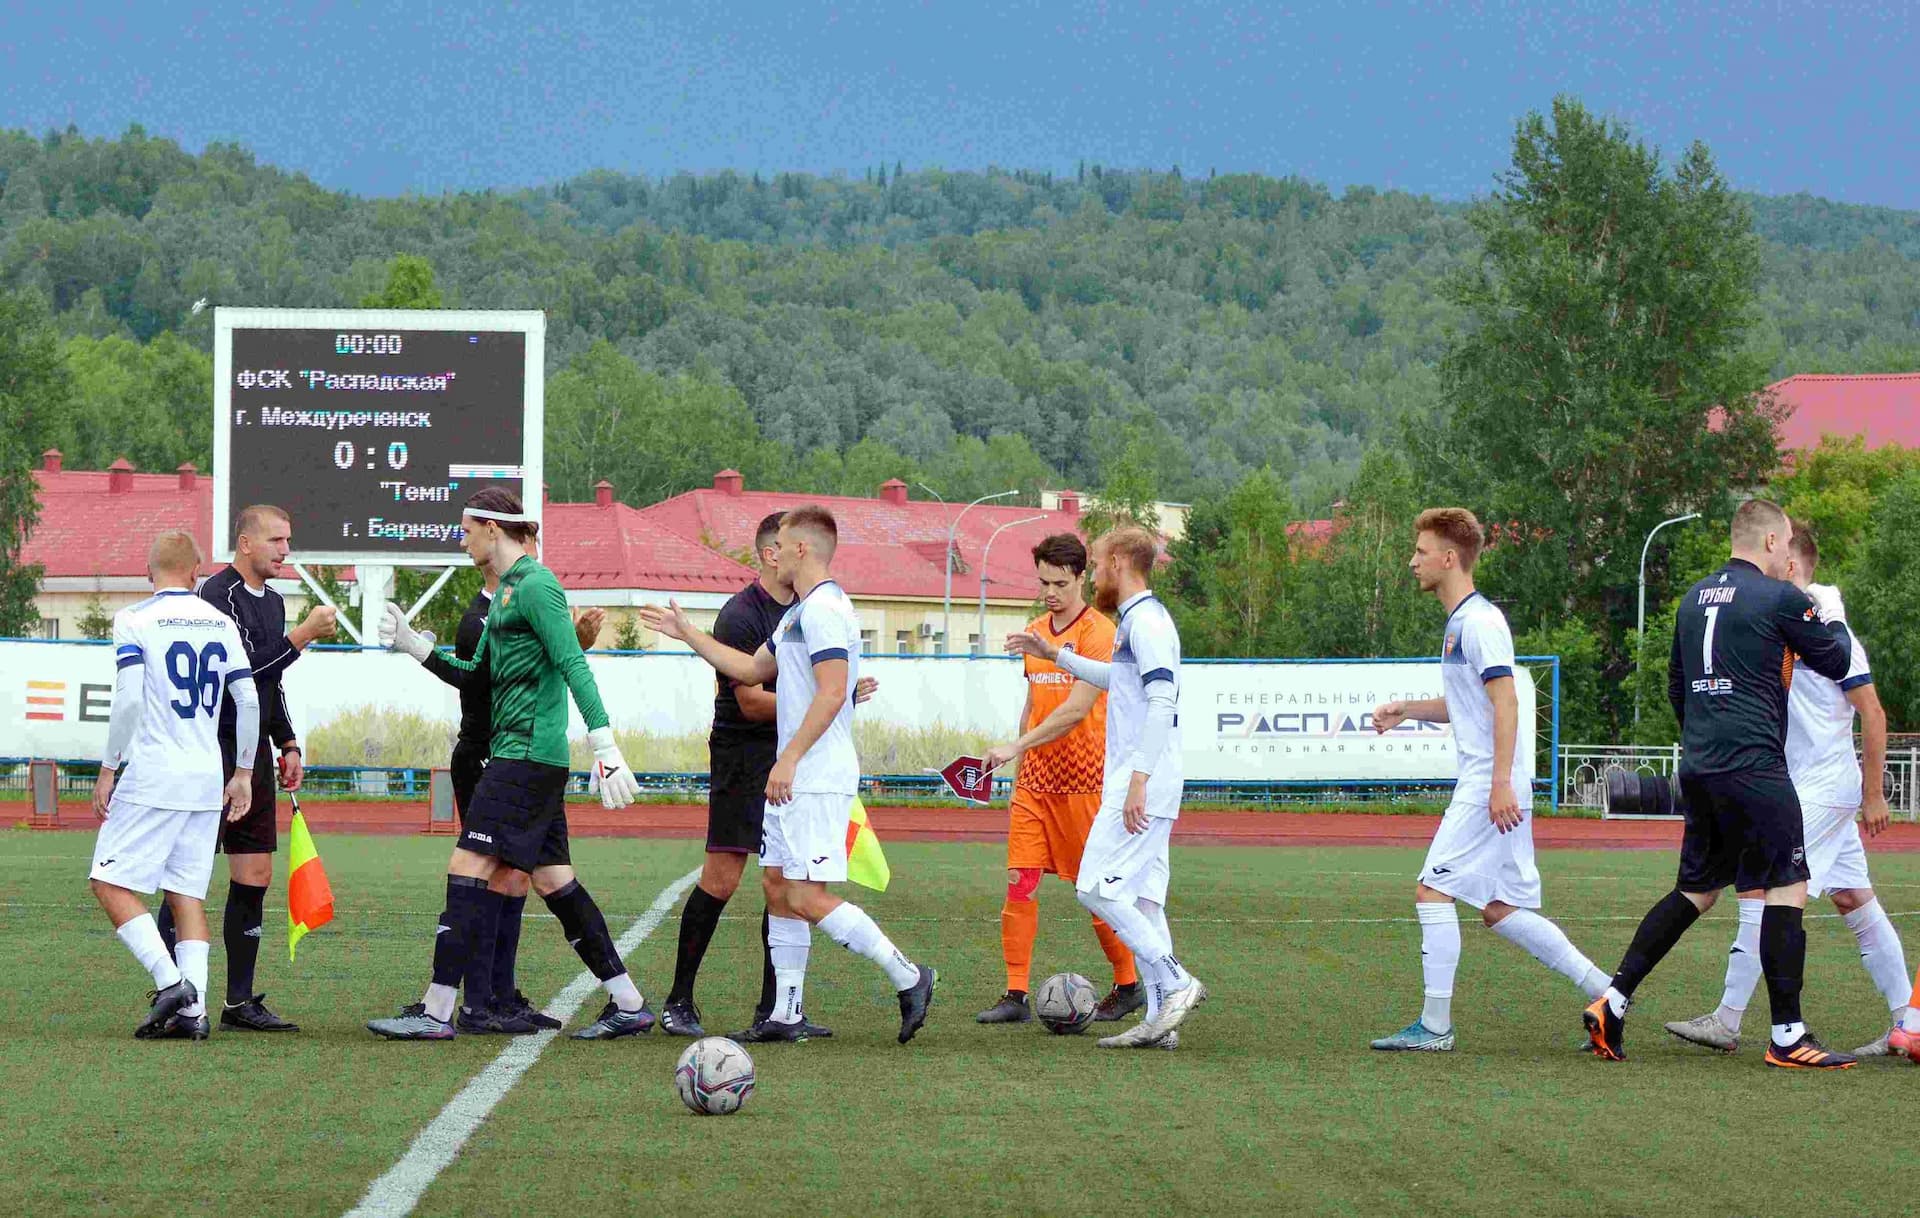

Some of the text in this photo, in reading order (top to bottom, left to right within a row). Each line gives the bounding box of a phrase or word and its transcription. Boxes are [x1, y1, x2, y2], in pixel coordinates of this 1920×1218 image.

[335, 334, 402, 354] 00:00
[236, 369, 456, 391] ФСК "Распадская"
[235, 407, 432, 430] г. Междуреченск
[380, 481, 459, 502] "Темп"
[342, 522, 359, 537] г.
[1697, 586, 1737, 606] ТРУБИН
[1702, 606, 1719, 675] 1
[165, 640, 228, 719] 96
[1216, 691, 1376, 705] ГЕНЕРАЛЬНЫЙ
[1217, 744, 1345, 754] УГОЛЬНАЯ
